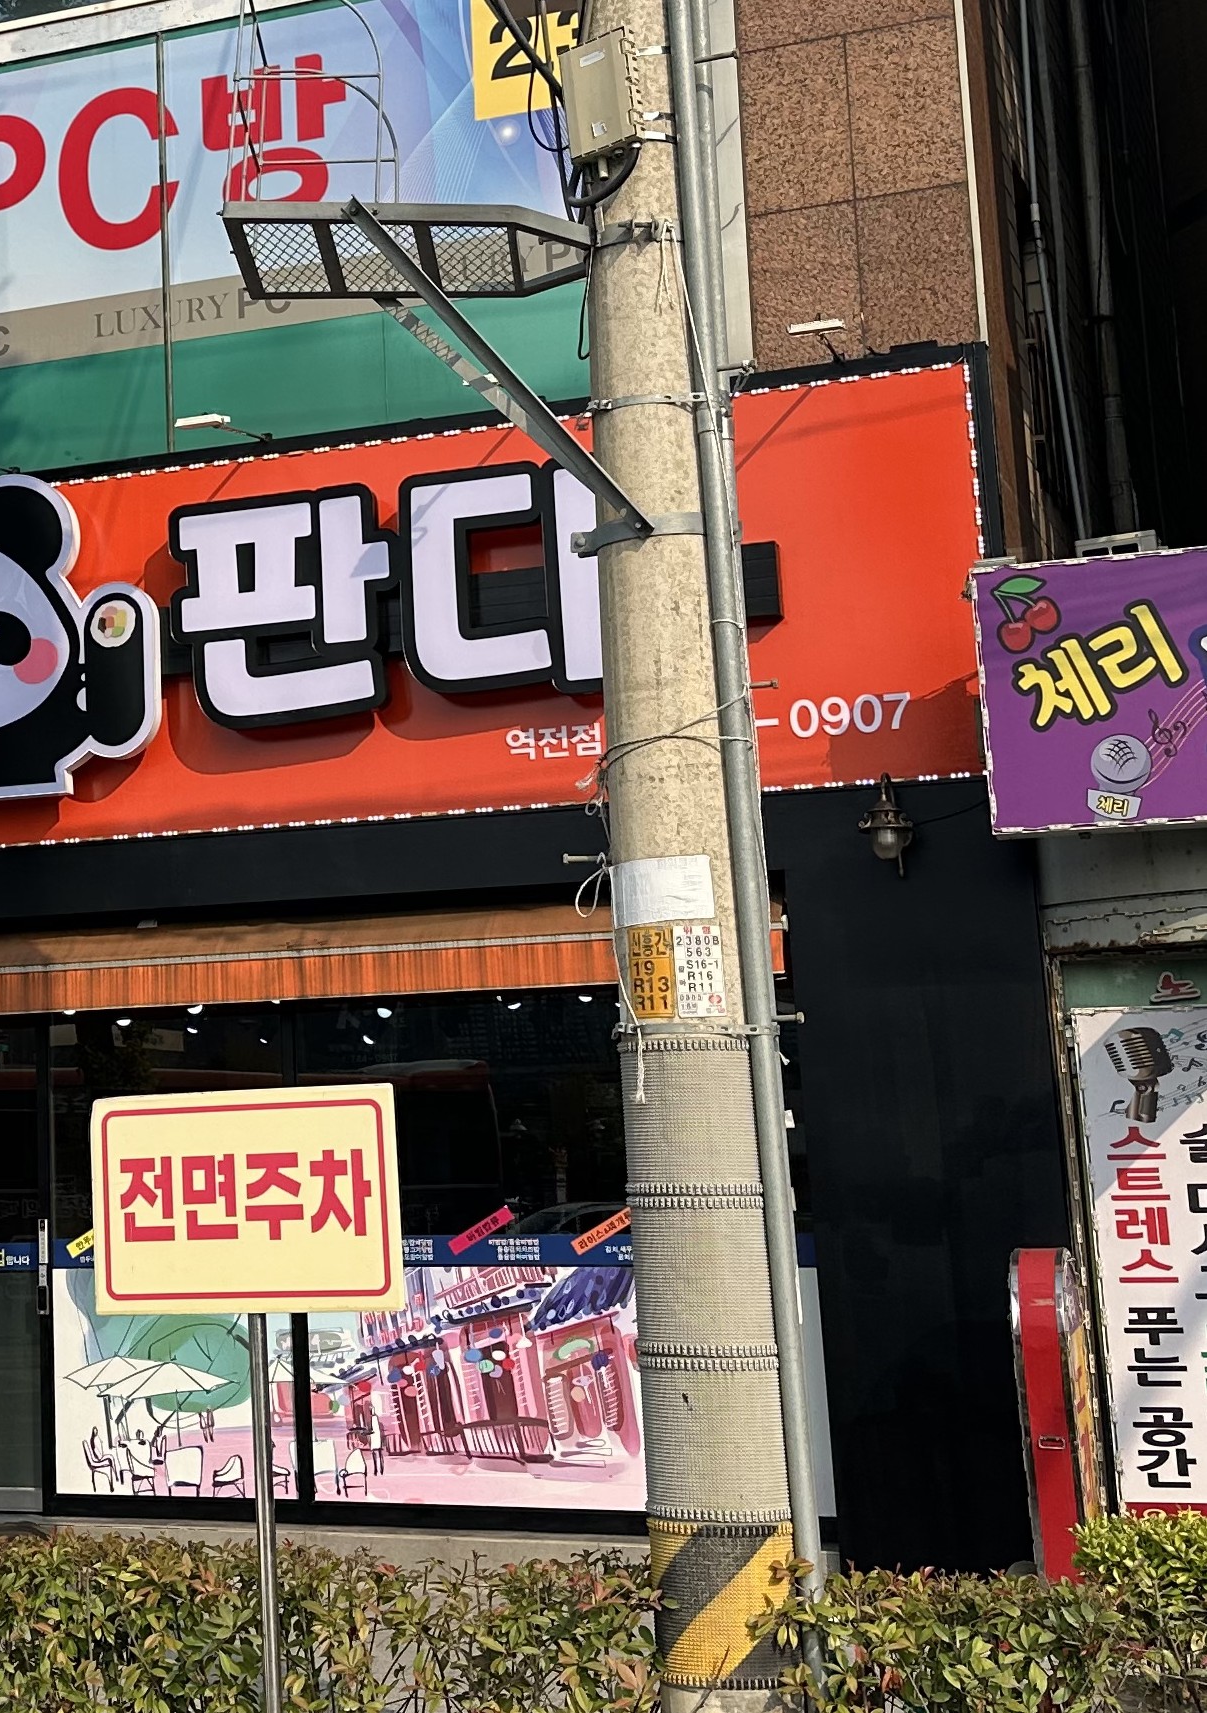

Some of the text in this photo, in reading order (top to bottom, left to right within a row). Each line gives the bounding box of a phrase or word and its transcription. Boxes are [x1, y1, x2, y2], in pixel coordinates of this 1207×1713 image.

[1017, 604, 1183, 728] 체리
[505, 722, 602, 760] 역전점
[1097, 794, 1129, 816] 체리
[633, 960, 655, 976] 19
[685, 947, 712, 957] 563
[119, 1147, 372, 1242] 전면주차
[1107, 1126, 1179, 1284] 스트레스
[1124, 1307, 1187, 1387] 푸는
[1133, 1406, 1197, 1489] 공간
